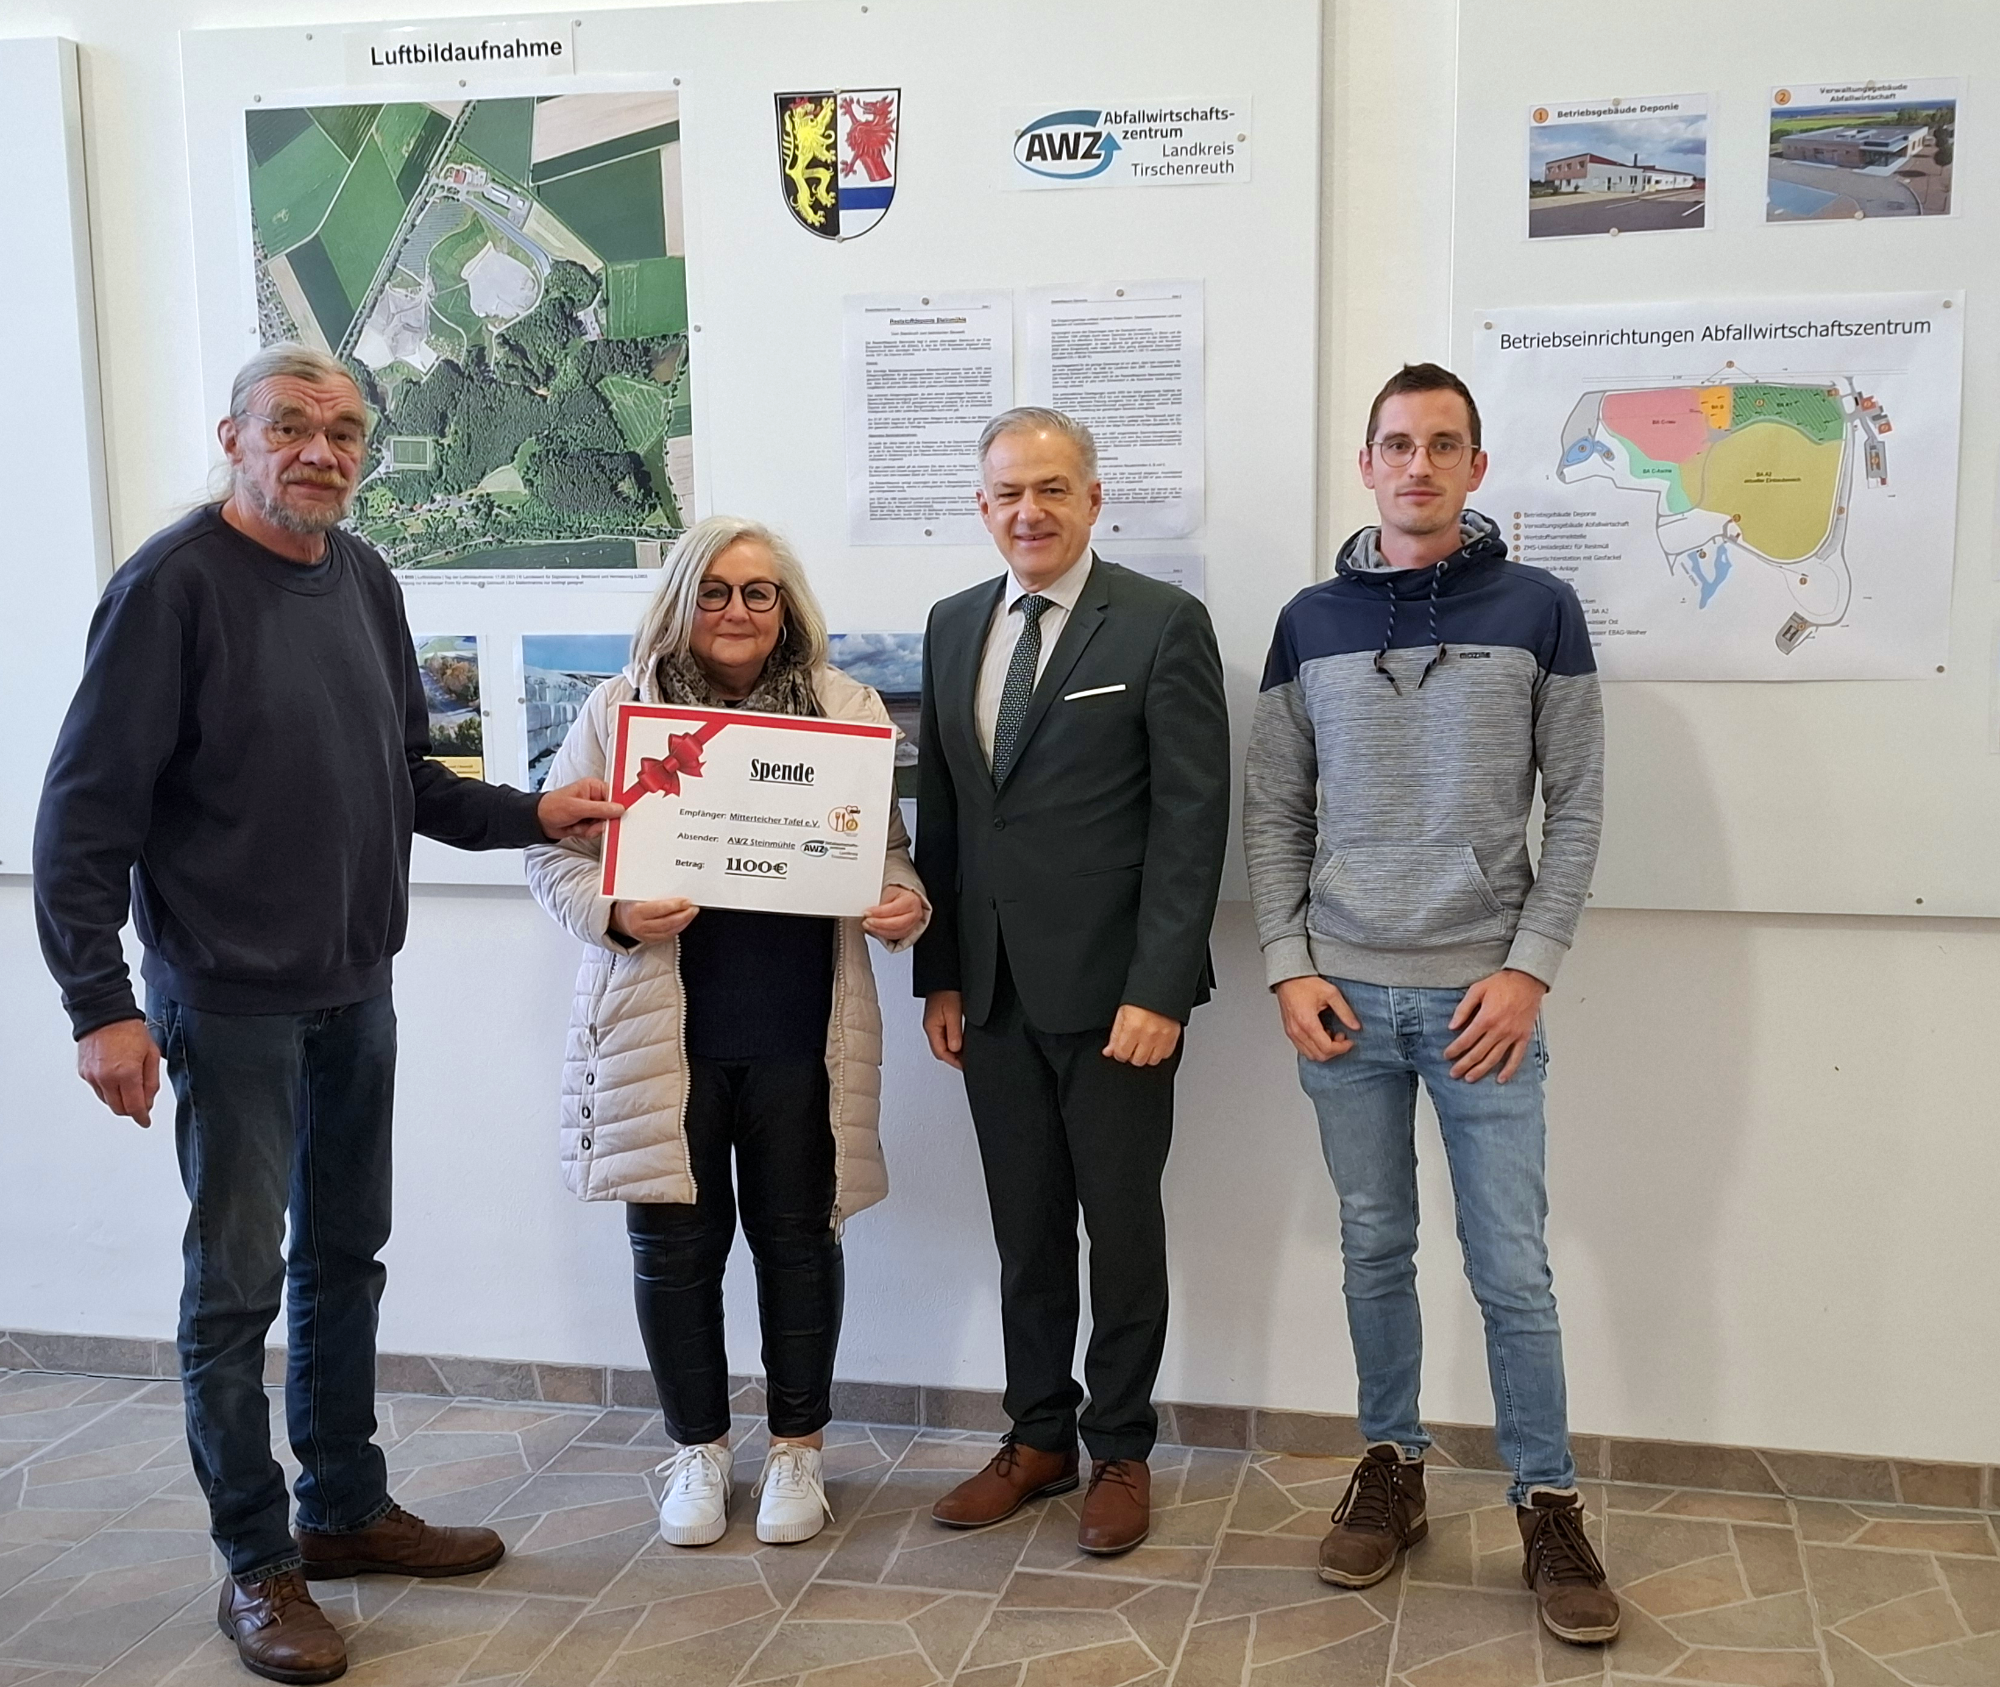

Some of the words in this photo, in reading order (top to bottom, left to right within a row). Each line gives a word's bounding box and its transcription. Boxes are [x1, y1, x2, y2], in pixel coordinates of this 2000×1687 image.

[371, 38, 562, 66] Luftbildaufnahme
[1830, 93, 1896, 103] Abfallwirtschaft
[1103, 106, 1236, 125] Abfallwirtschafts-
[1557, 106, 1637, 119] Betriebsgebäude
[1640, 103, 1679, 115] Deponie
[1122, 126, 1183, 140] zentrum
[1025, 131, 1102, 162] AWZ
[1162, 142, 1235, 158] Landkreis
[1131, 160, 1235, 177] Tirschenreuth
[1500, 328, 1695, 349] Betriebseinrichtungen
[1701, 320, 1931, 342] Abfallwirtschaftszentrum
[750, 758, 815, 784] Spende
[679, 808, 727, 820] Empfänger:
[729, 813, 782, 825] Mitterteicher
[783, 817, 803, 827] Tafel
[805, 819, 820, 828] e.V.
[677, 832, 719, 843] Absender:
[727, 837, 749, 846] AWZ
[750, 838, 795, 849] Steinmühle
[804, 844, 825, 853] AWZ
[675, 859, 705, 870] Betrag:
[725, 857, 788, 875] 1100€
